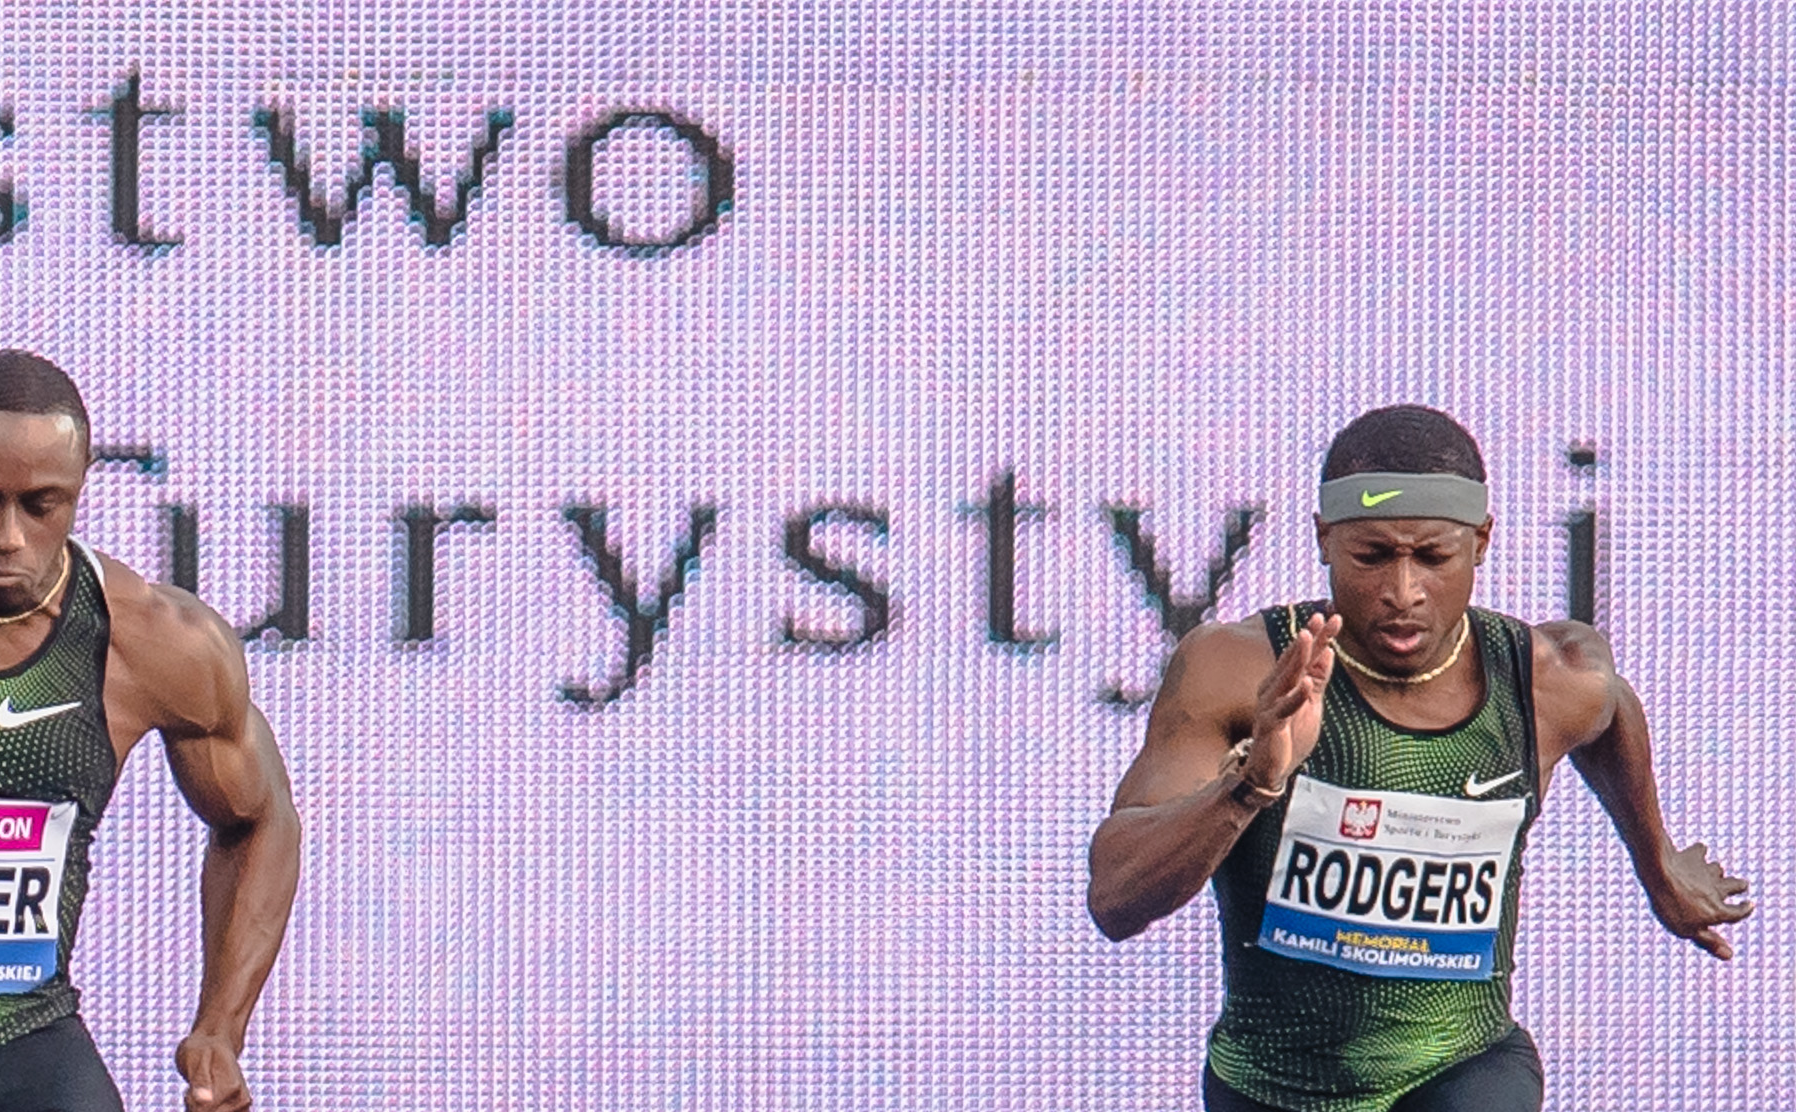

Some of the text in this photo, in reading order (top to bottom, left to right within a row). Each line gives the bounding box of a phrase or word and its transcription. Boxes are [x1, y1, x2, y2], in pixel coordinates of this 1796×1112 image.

[88, 442, 1614, 710] urystyi
[1280, 840, 1497, 925] RODGERS
[1273, 928, 1482, 970] KAMILI SKOLIMOWSKIEJ
